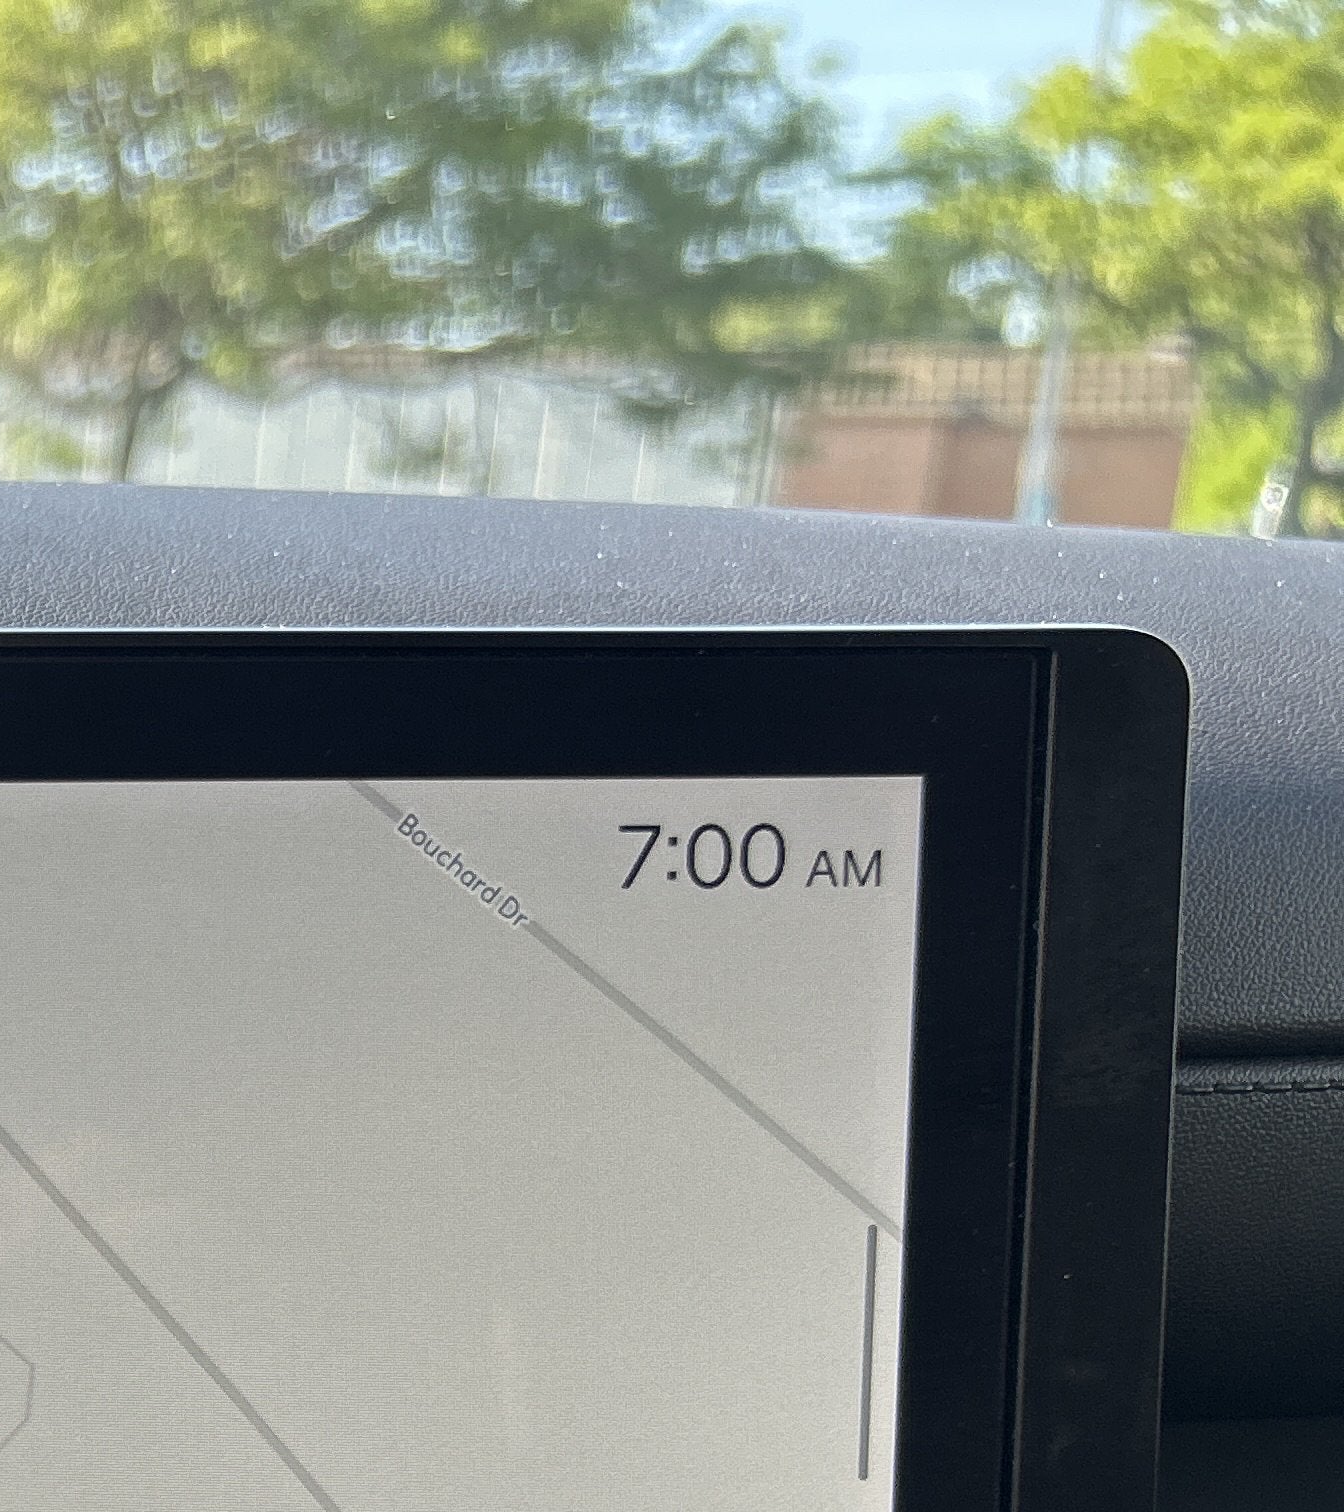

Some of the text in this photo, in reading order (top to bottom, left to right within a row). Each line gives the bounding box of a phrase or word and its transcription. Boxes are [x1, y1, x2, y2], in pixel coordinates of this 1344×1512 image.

[397, 813, 528, 928] Bouchard Dr
[618, 823, 883, 889] 7:00 AM
